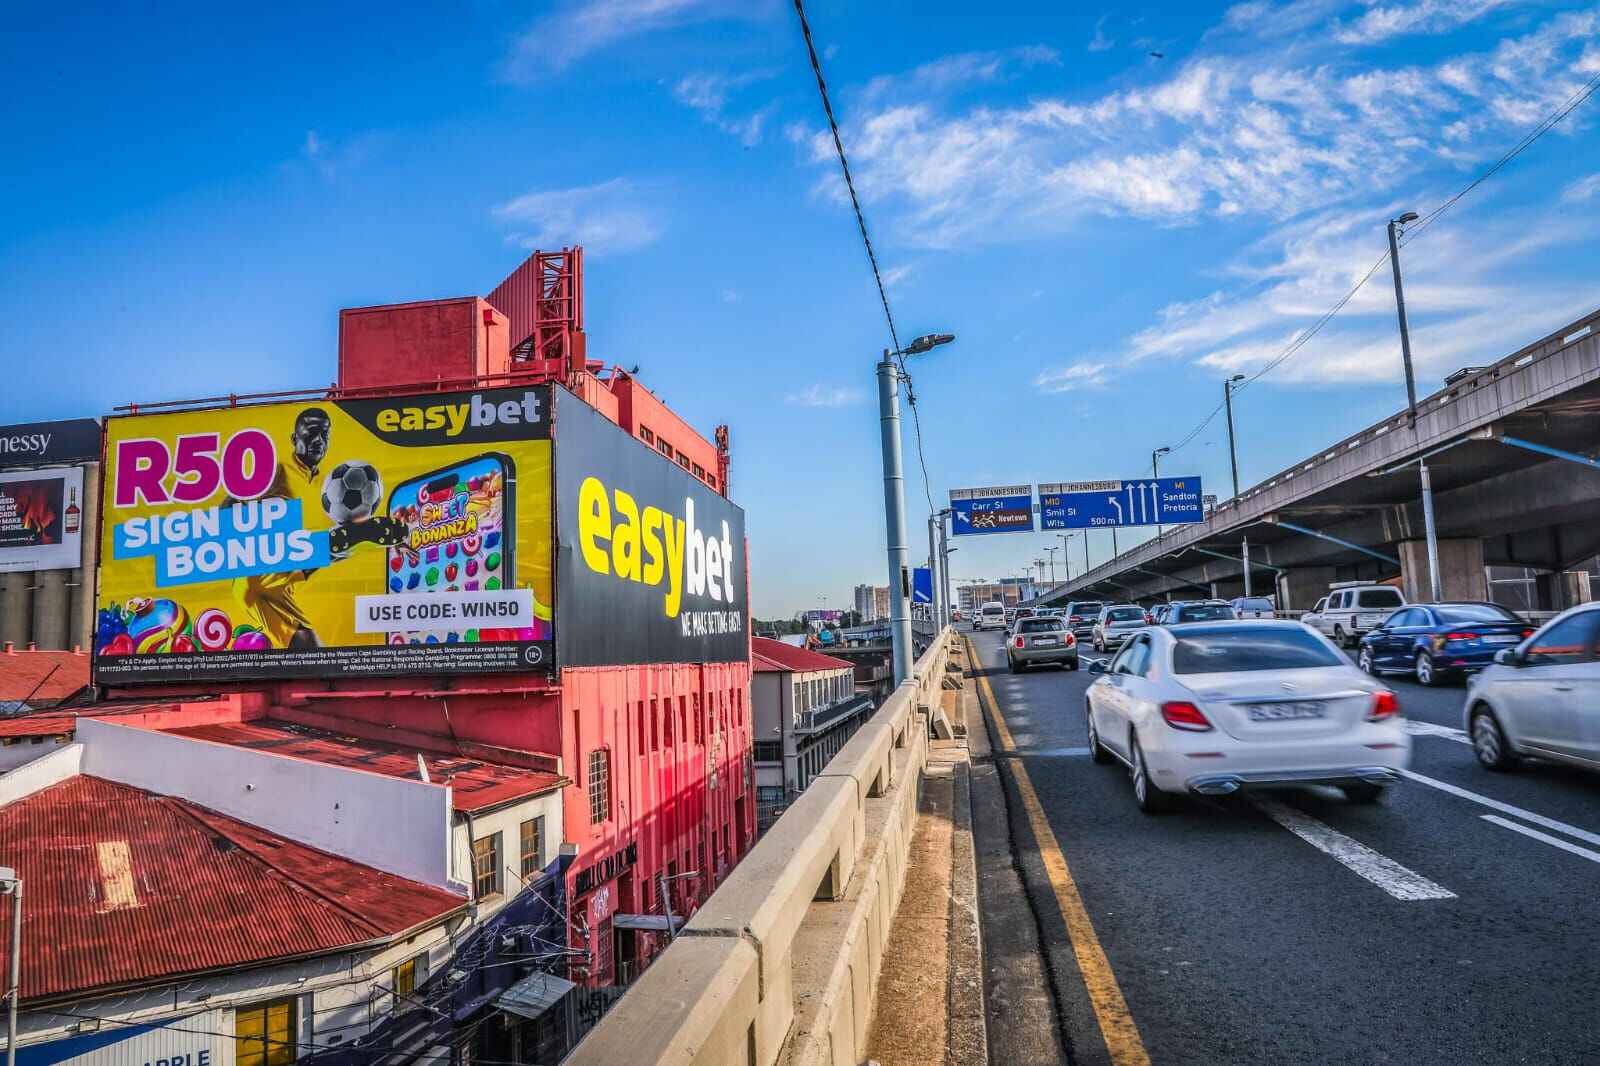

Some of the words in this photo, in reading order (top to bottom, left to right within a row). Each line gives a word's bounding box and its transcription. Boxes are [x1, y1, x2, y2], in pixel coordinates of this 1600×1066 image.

[376, 391, 541, 436] easybet
[0, 433, 51, 455] nessy
[113, 427, 277, 508] R50
[978, 487, 1027, 497] JOHANNESBURG
[1162, 492, 1197, 502] Sandton
[421, 494, 468, 527] SWEET
[972, 502, 991, 511] Carr
[994, 501, 1004, 509] St
[1046, 508, 1065, 517] Smit
[1067, 507, 1076, 516] St
[1163, 504, 1197, 512] Pretoria
[123, 506, 220, 549] SIGN
[232, 497, 287, 533] UP
[998, 514, 1027, 523] Newtown
[1046, 519, 1065, 527] Wits
[1091, 517, 1106, 525] 500
[411, 513, 477, 549] BONANZA
[166, 529, 314, 578] BONUS
[578, 476, 734, 618] easybet
[369, 605, 402, 621] USE
[407, 603, 456, 619] CODE:
[461, 601, 519, 618] WIN50
[680, 611, 691, 638] WE
[692, 611, 707, 638] MAKE
[708, 611, 728, 636] BETTING
[144, 1049, 210, 1066] PLE
